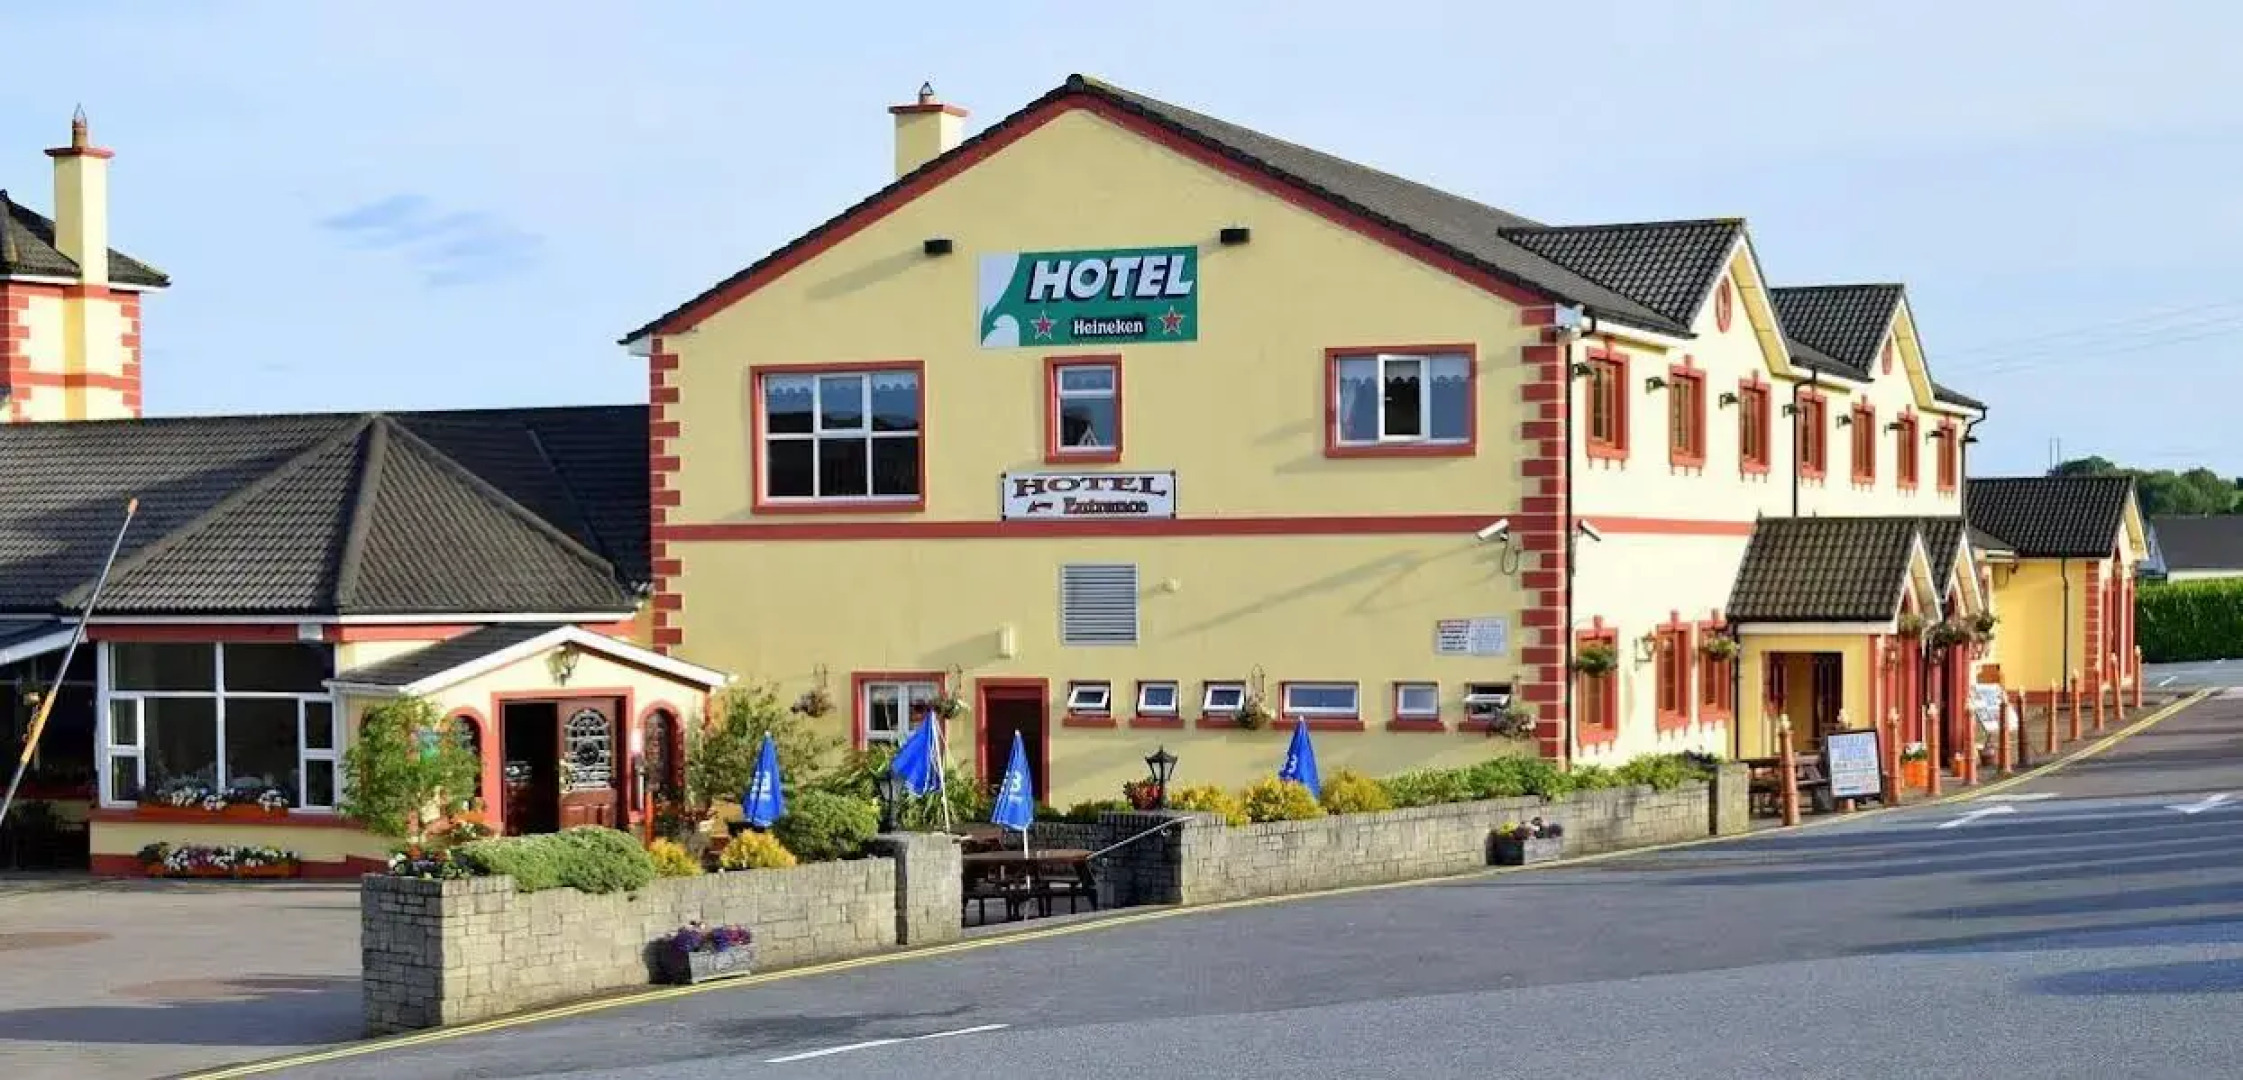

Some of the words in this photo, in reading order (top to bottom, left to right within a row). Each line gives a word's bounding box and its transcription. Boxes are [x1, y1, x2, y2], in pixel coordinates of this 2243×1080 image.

[1028, 254, 1194, 301] HOTEL
[1074, 318, 1144, 335] Heineken
[1012, 476, 1168, 498] HOTEL
